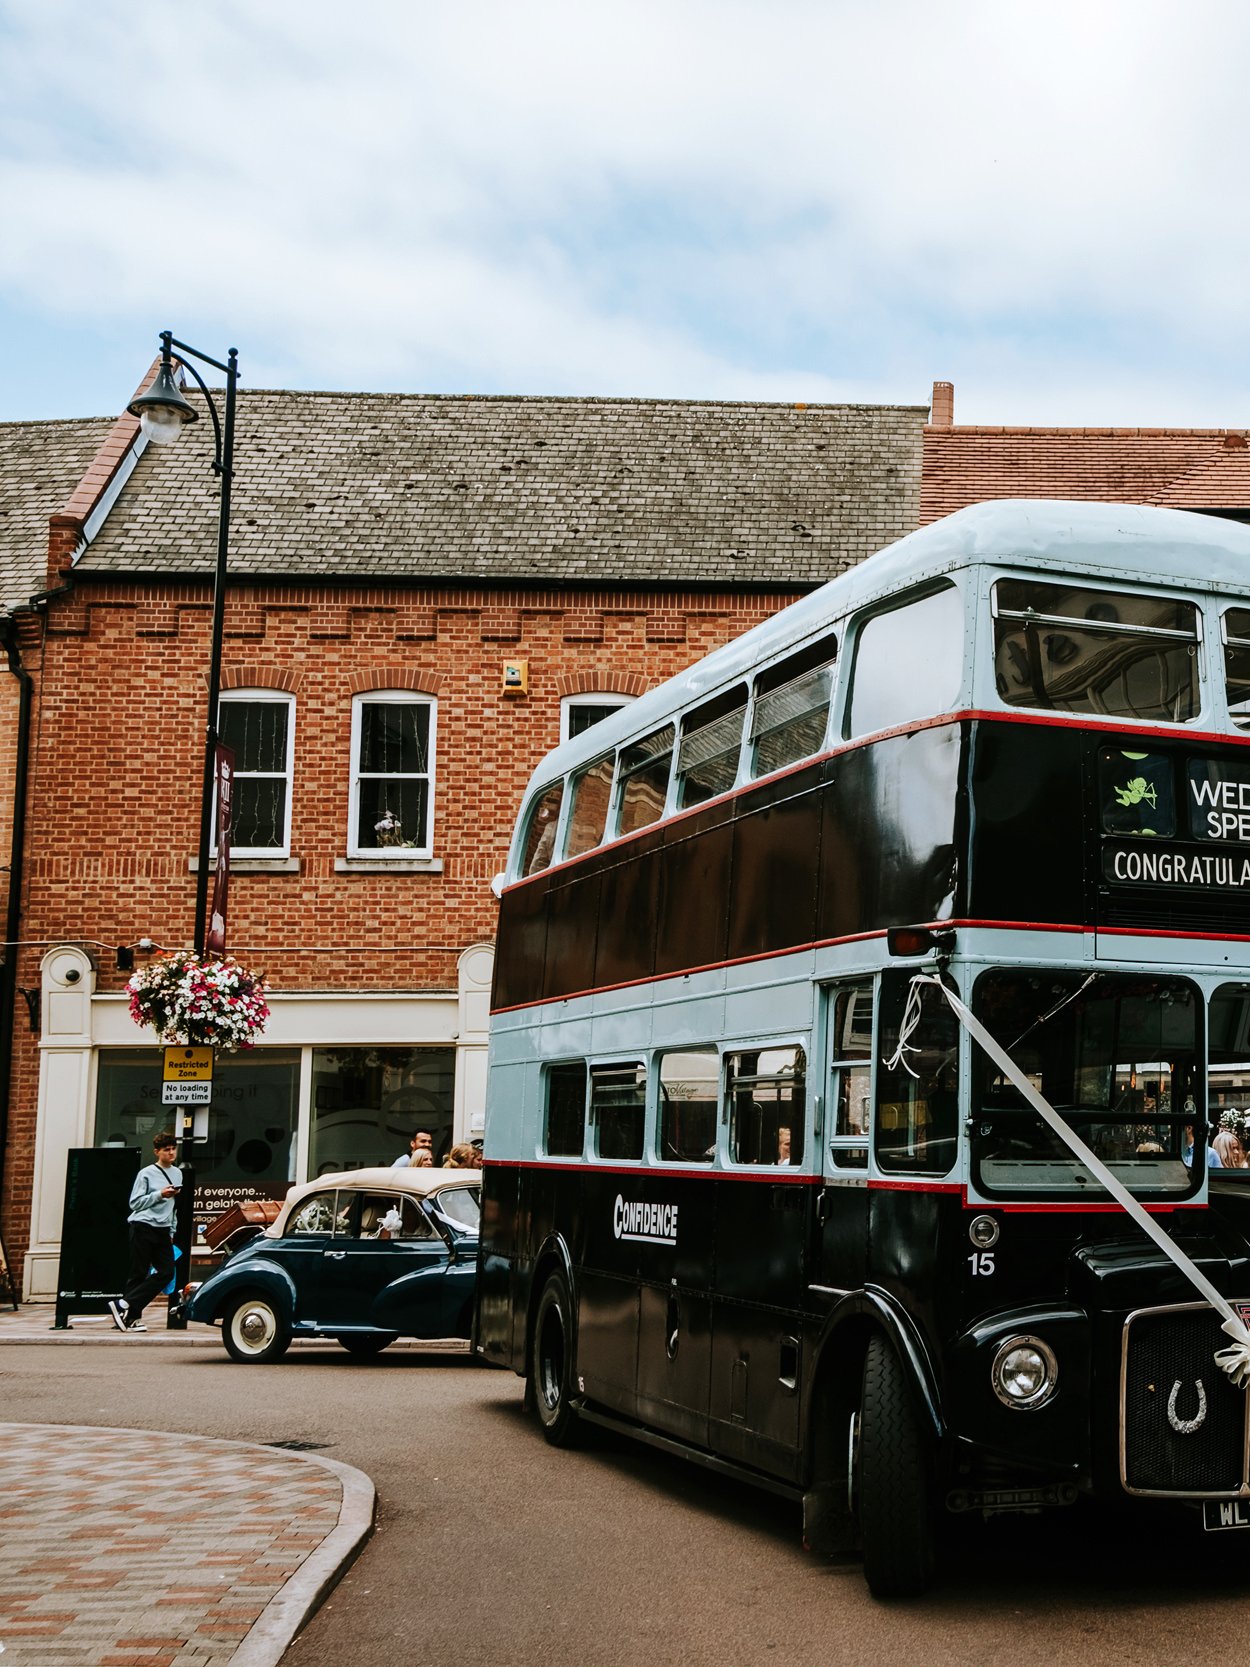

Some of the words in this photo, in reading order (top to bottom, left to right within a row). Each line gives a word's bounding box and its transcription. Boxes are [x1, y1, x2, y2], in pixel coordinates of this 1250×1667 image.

[168, 1061, 209, 1069] Restricted
[178, 1070, 198, 1078] Zone
[166, 1084, 178, 1092] No
[179, 1083, 209, 1093] loading
[165, 1093, 174, 1101] at
[175, 1094, 189, 1102] any
[204, 1187, 266, 1198] everyone...
[613, 1193, 679, 1240] CONFIDENCE
[967, 1252, 995, 1276] 15
